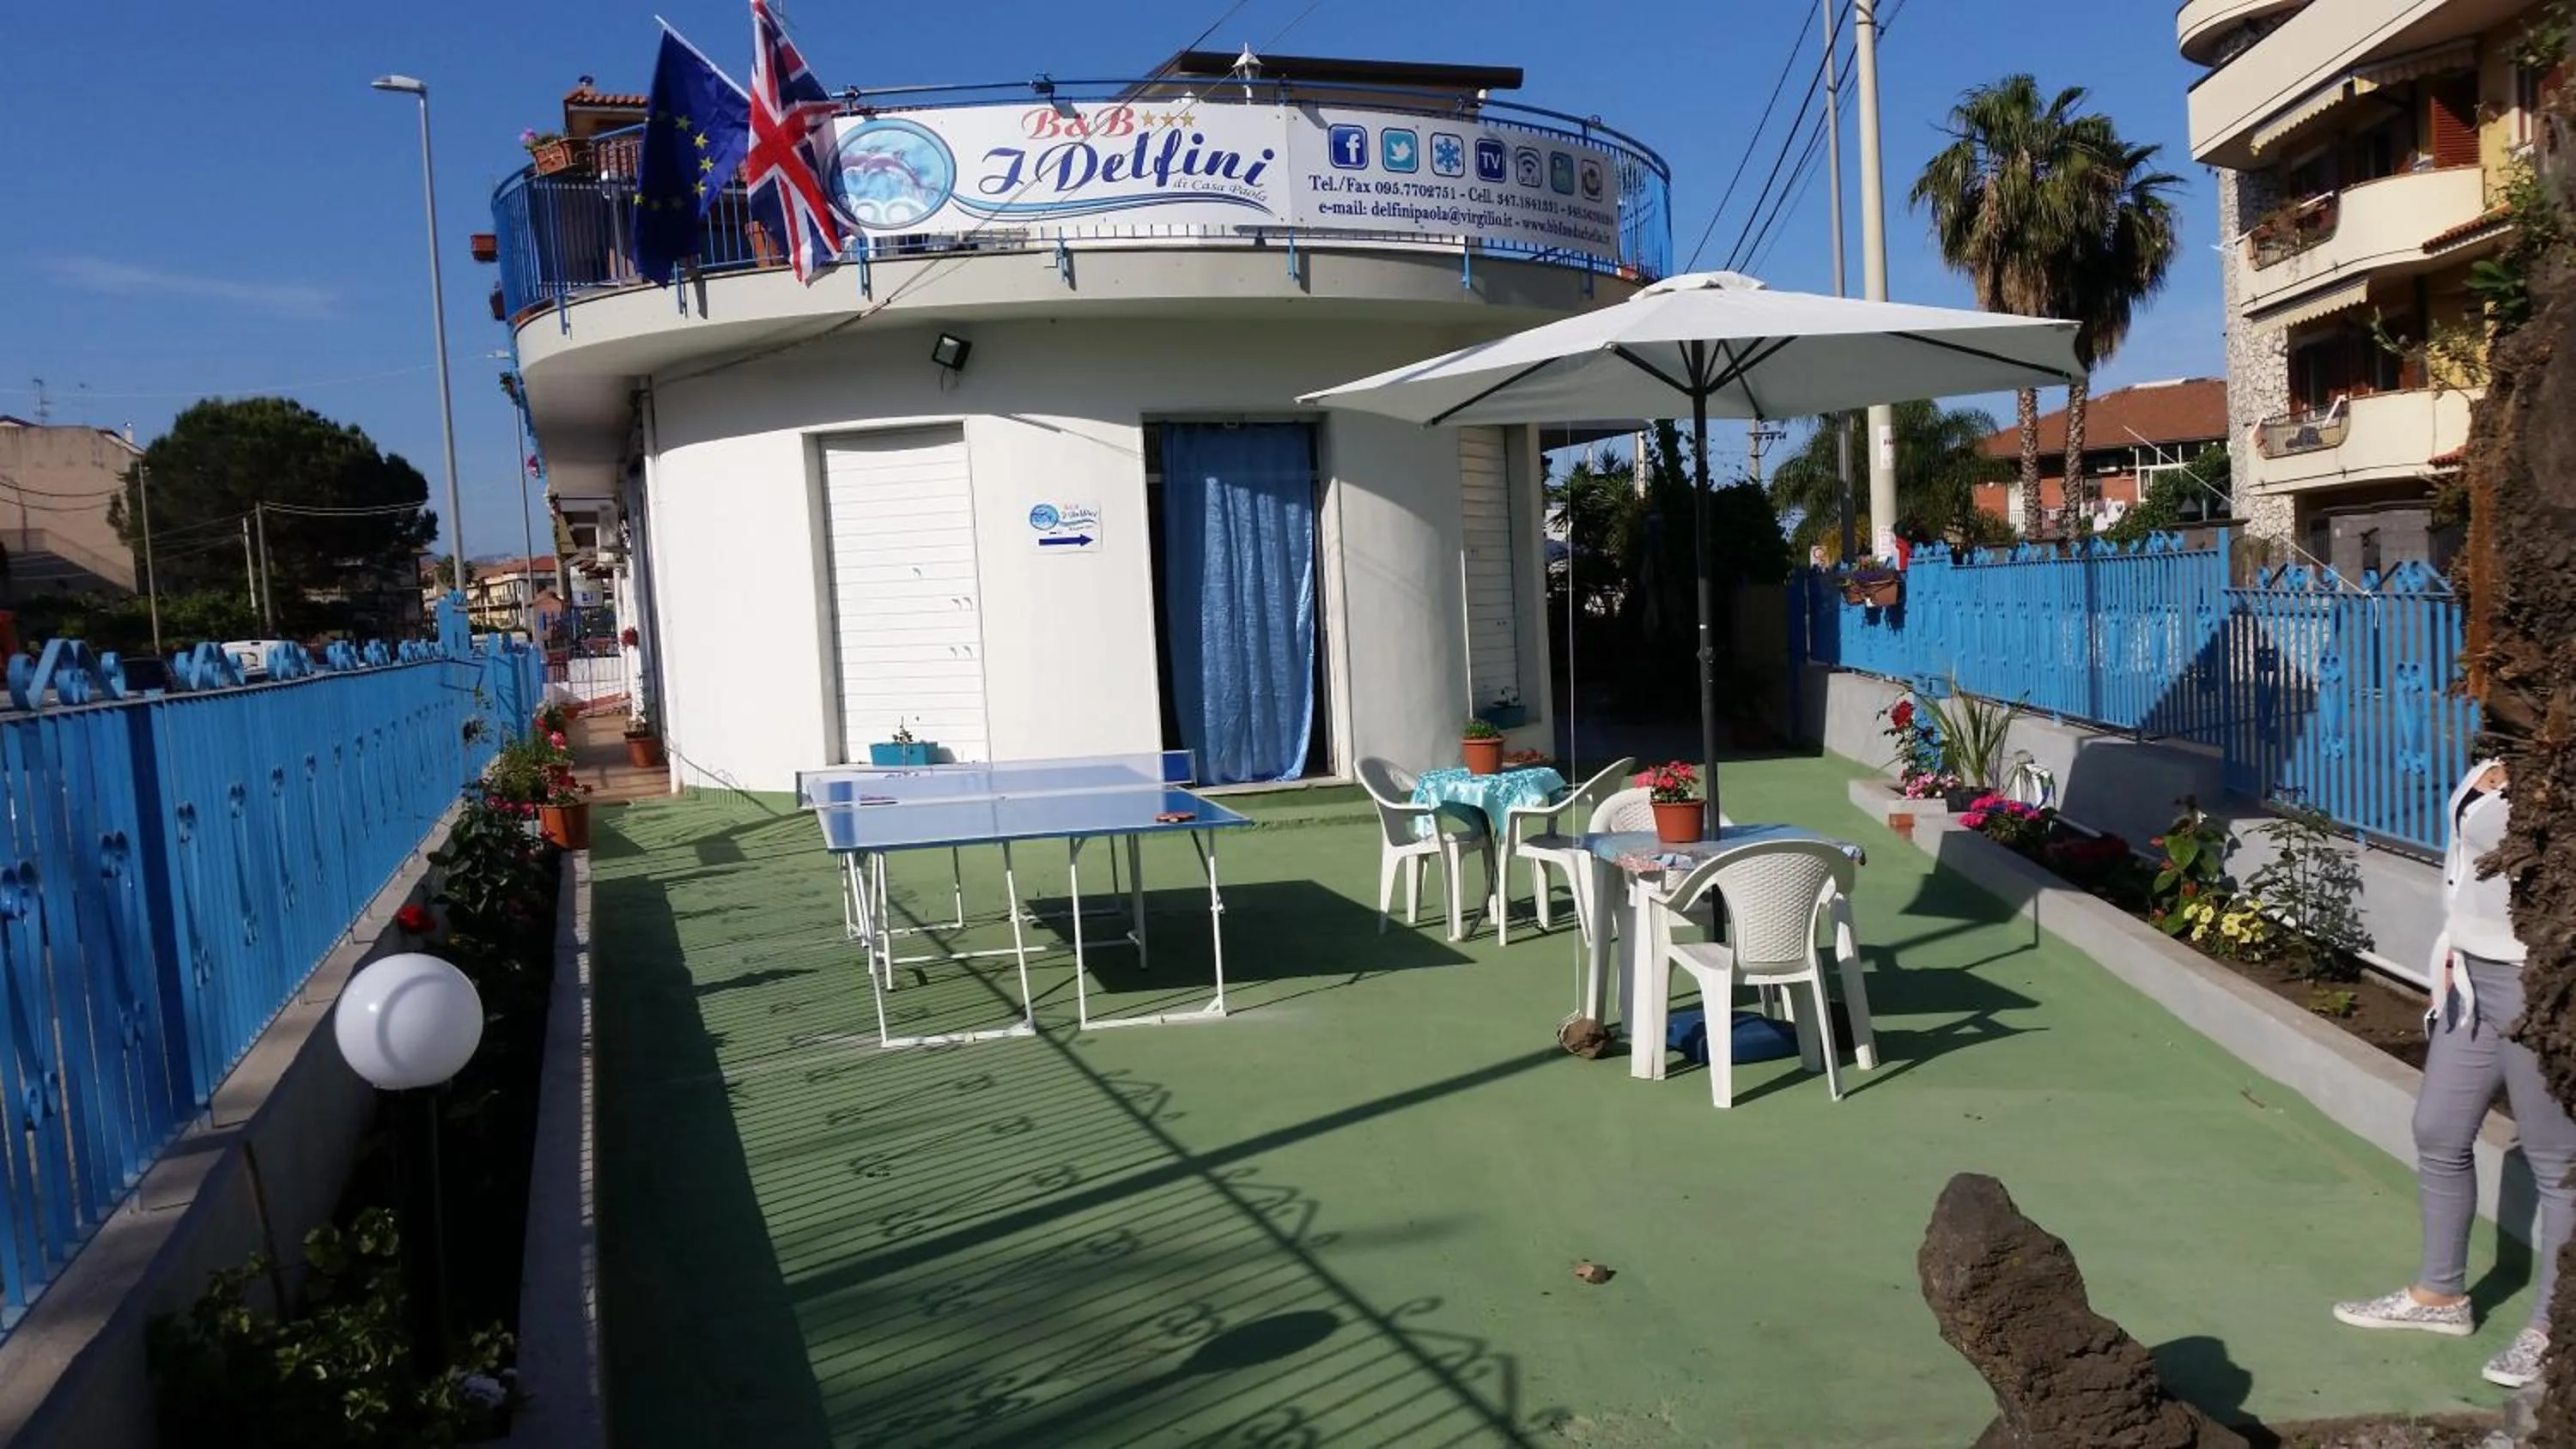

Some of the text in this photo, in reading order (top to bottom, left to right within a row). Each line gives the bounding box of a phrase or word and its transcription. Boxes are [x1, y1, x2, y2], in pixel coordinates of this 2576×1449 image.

[1021, 106, 1135, 140] B&B
[1035, 129, 1275, 193] Delfini
[1479, 152, 1501, 169] TV
[1191, 179, 1224, 191] Casa
[1230, 184, 1267, 202] Paola
[1308, 174, 1371, 193] Tel./Fax
[1318, 200, 1368, 215] e-mail:
[1371, 201, 1513, 228] delfinipaola@virgilio.it
